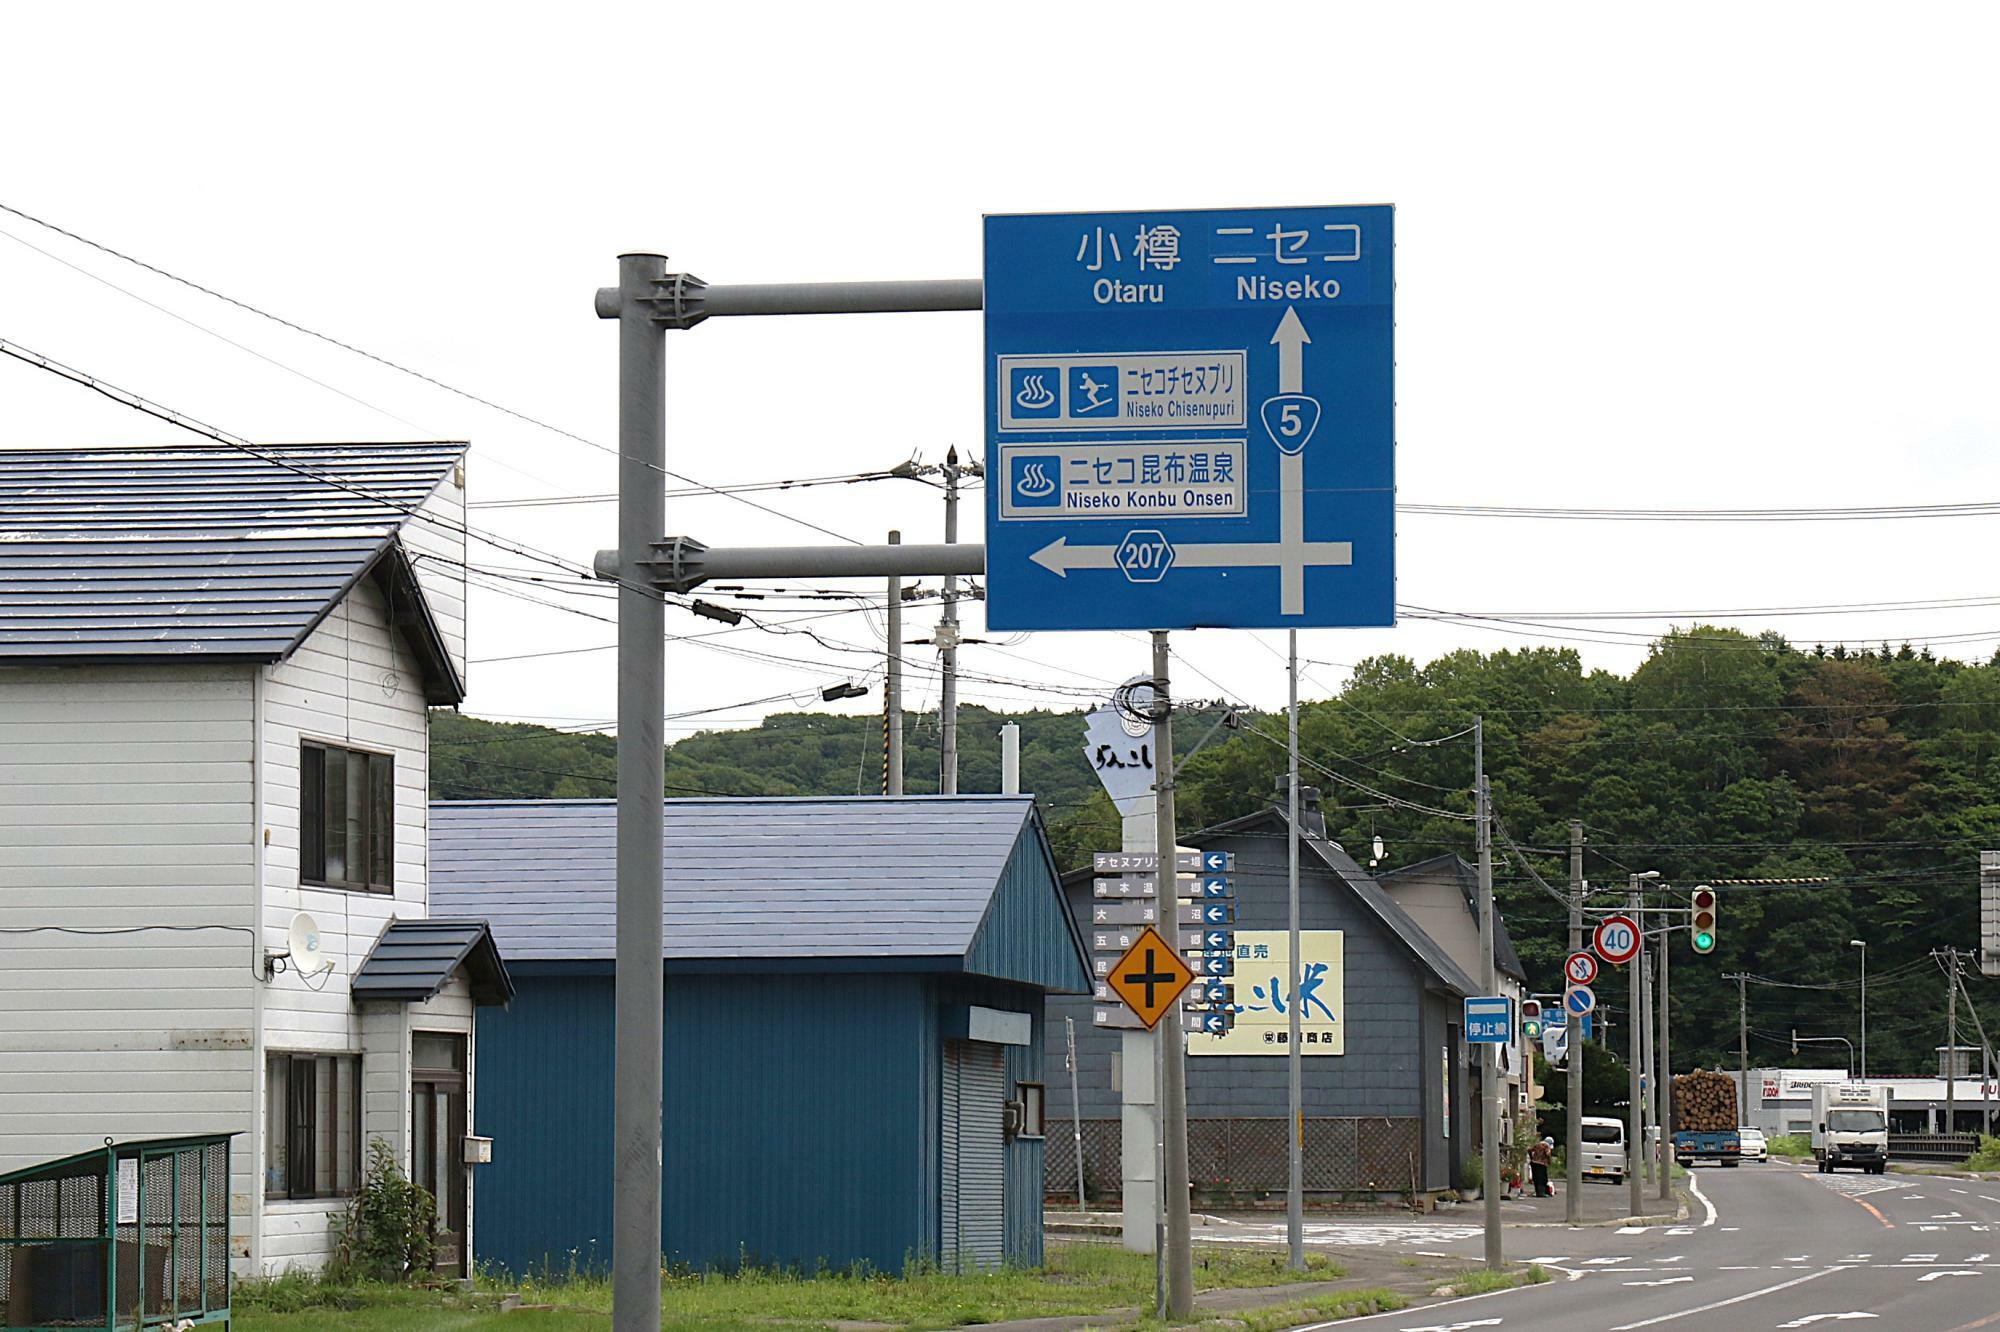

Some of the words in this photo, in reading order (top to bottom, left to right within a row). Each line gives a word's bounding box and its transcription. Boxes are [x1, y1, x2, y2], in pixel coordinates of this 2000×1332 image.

[1076, 224, 1181, 271] 小樽
[1214, 223, 1361, 264] ニセコ
[1093, 279, 1164, 303] Otaru
[1237, 275, 1341, 300] Niseko
[1126, 362, 1234, 396] ニセコチセヌプリ
[1126, 402, 1164, 418] Niseko
[1168, 400, 1235, 420] Chisenupuri
[1280, 405, 1301, 437] 5
[1068, 453, 1235, 486] ニセコ昆布温泉
[1067, 492, 1121, 509] Niseko
[1126, 491, 1177, 508] Konbu
[1183, 490, 1233, 507] Onsen
[1125, 543, 1165, 569] 207
[1604, 929, 1630, 949] 40
[1469, 1021, 1508, 1037] 停止線
